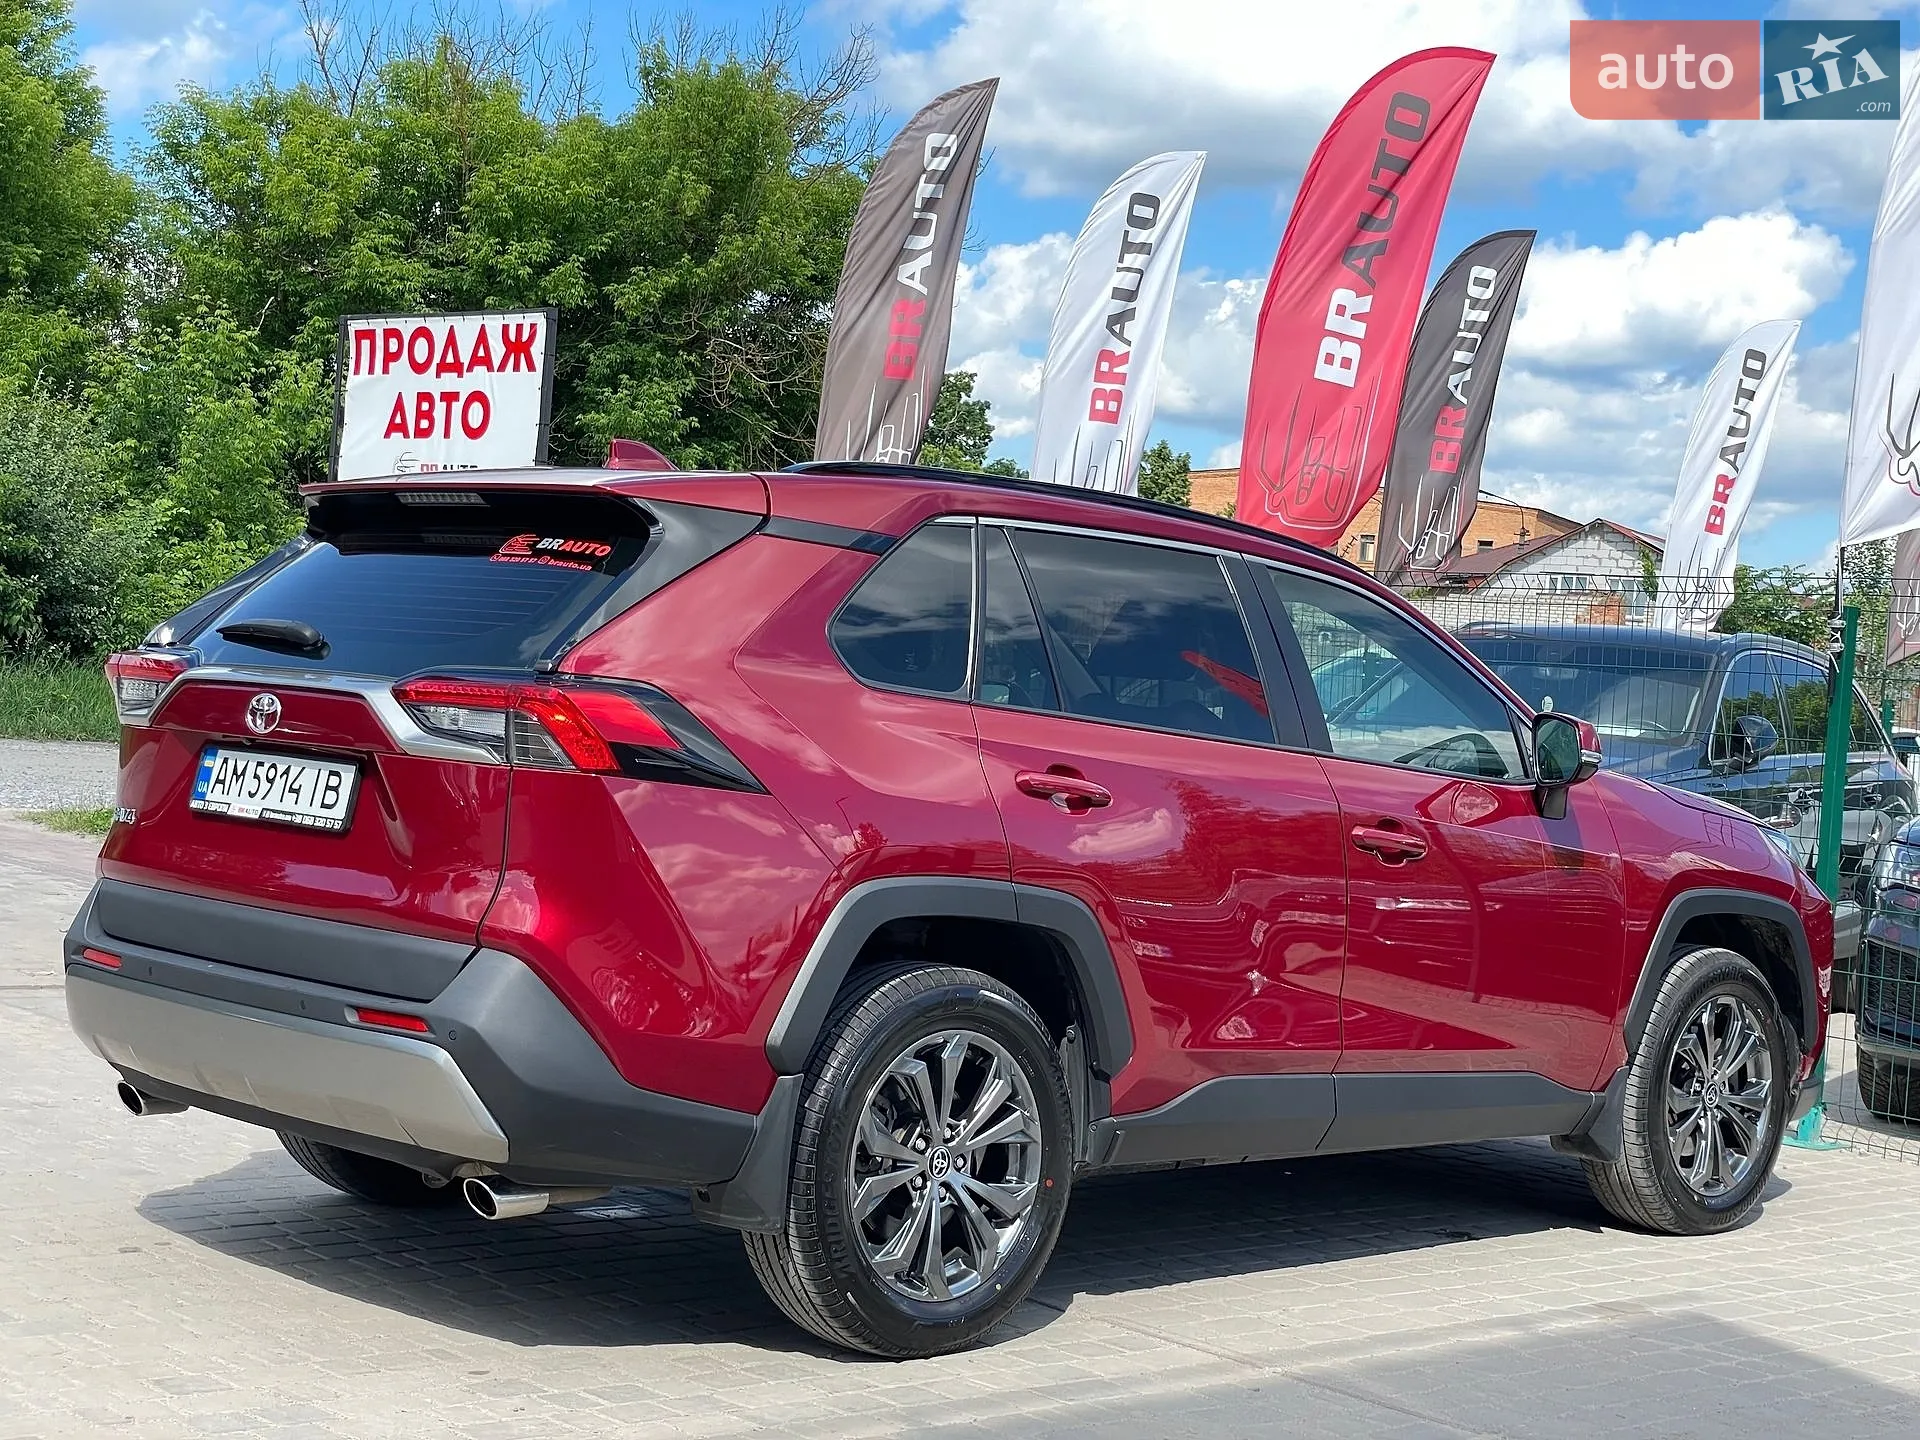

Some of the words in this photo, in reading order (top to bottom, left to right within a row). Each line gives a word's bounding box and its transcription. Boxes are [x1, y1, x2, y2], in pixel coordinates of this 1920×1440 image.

[884, 132, 958, 381] BRAUTO
[1313, 91, 1431, 388] BRAUTO
[353, 323, 539, 379] ПРОДАЖ
[1088, 192, 1161, 425] BRAUTO
[1429, 265, 1497, 474] BRAUTO
[383, 390, 491, 440] АВТО
[1704, 348, 1767, 536] BRAUTO
[536, 537, 612, 556] BRAUTO
[547, 559, 592, 571] brauto.ua
[197, 781, 208, 793] UA
